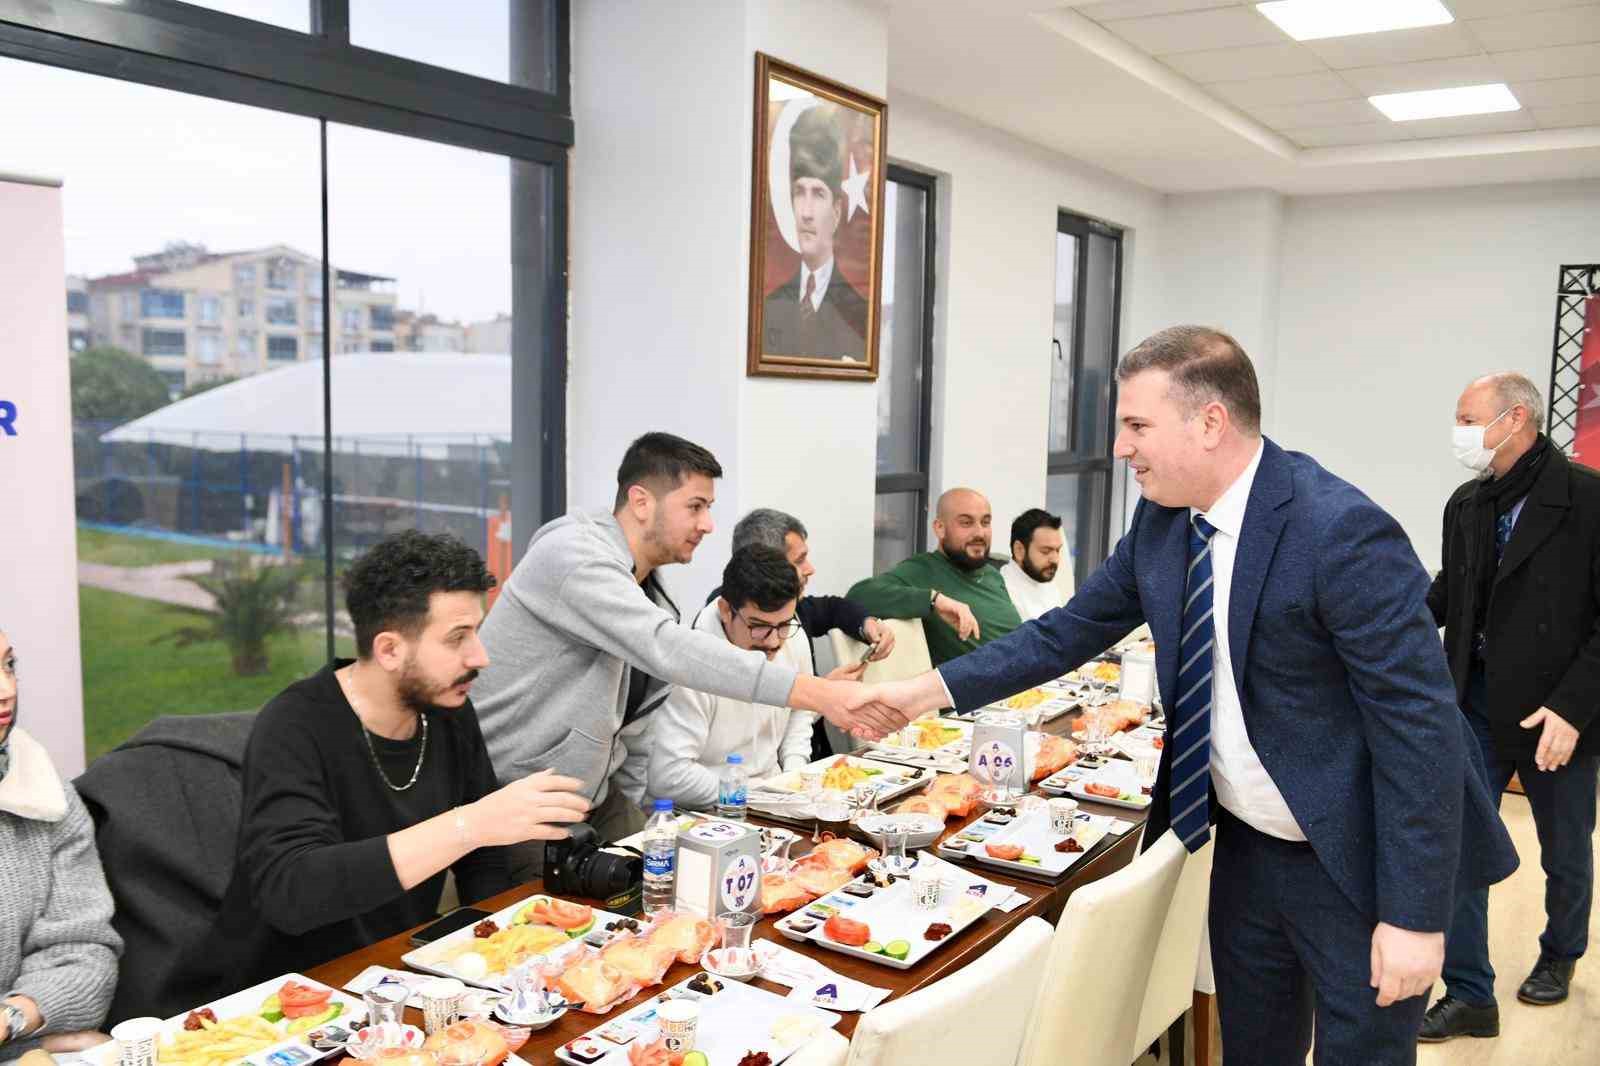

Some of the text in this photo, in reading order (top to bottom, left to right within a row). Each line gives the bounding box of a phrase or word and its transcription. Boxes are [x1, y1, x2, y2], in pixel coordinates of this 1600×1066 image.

[978, 754, 1013, 768] A 06
[726, 872, 755, 895] T 07
